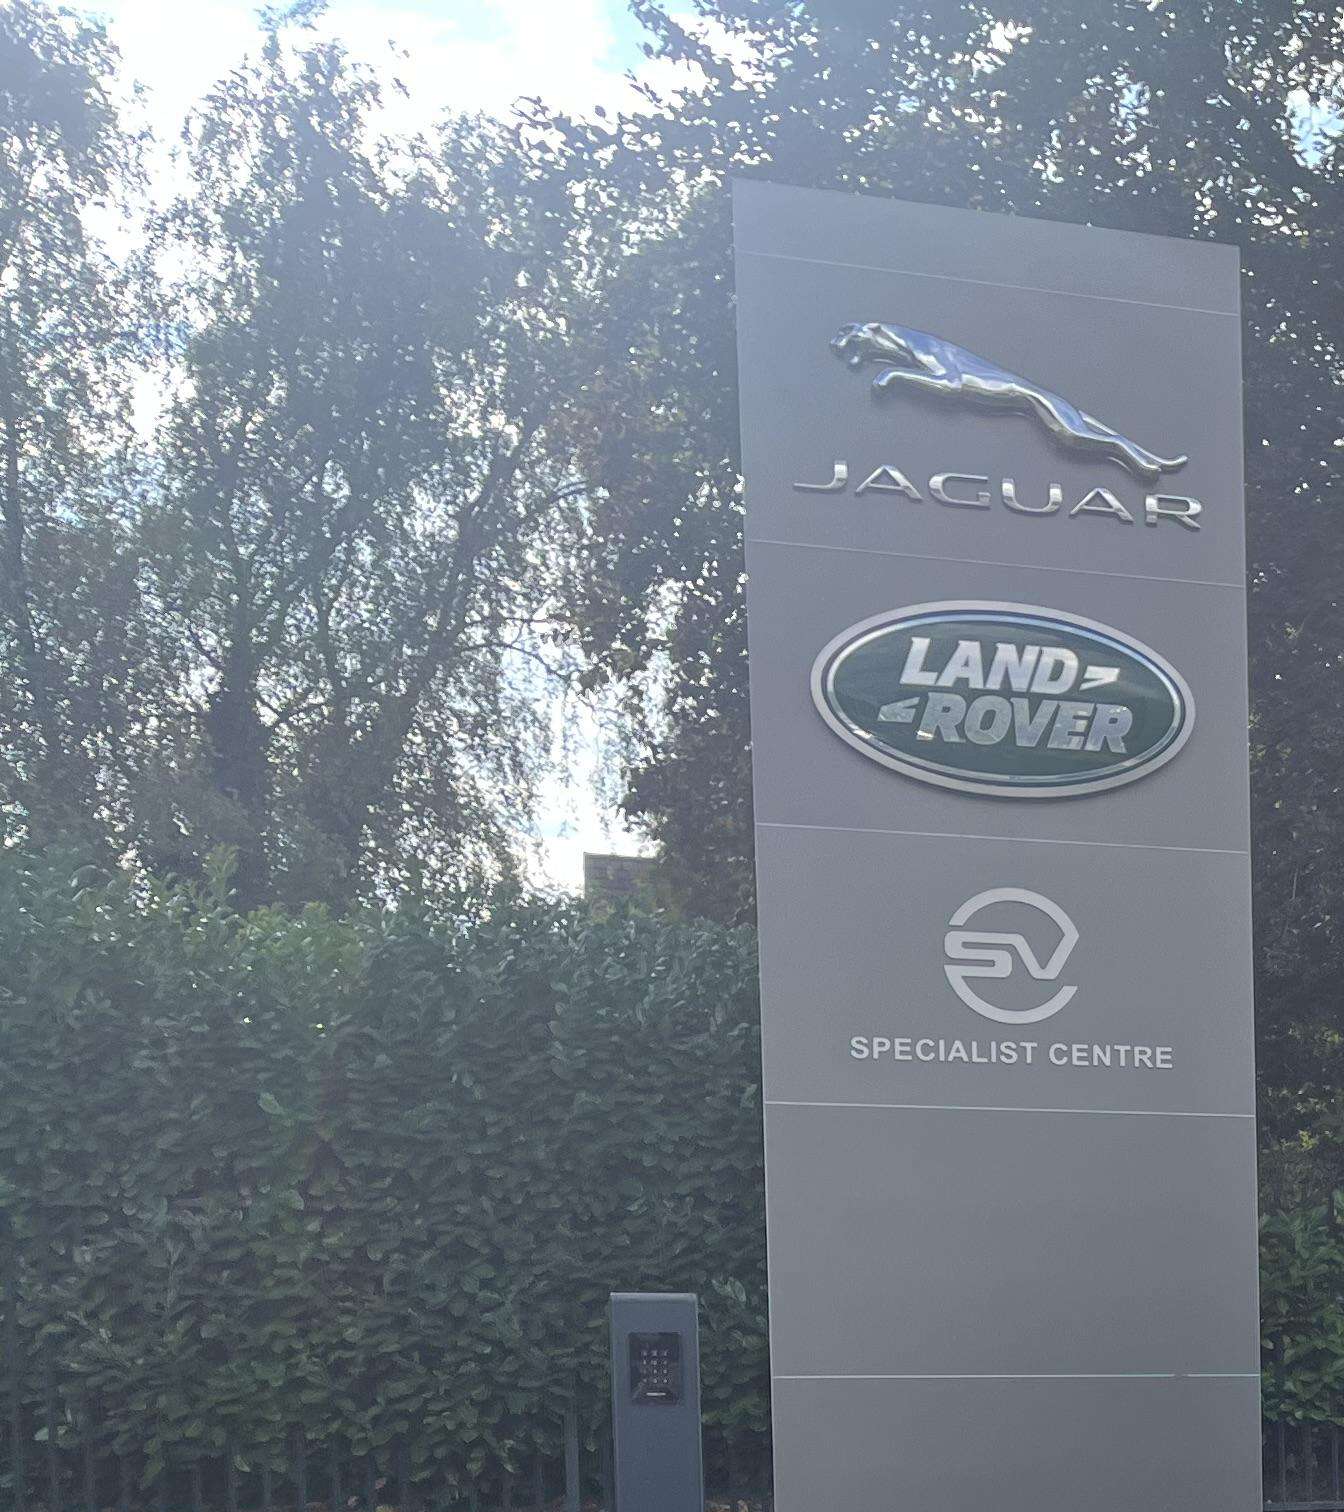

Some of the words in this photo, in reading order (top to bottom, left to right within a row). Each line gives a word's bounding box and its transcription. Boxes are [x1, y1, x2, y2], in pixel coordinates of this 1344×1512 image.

[794, 460, 1203, 530] JAGUAR
[900, 636, 1079, 696] LAND
[917, 691, 1133, 755] ROVER
[849, 1035, 1038, 1066] SPECIALIST
[1048, 1042, 1174, 1070] CENTRE
